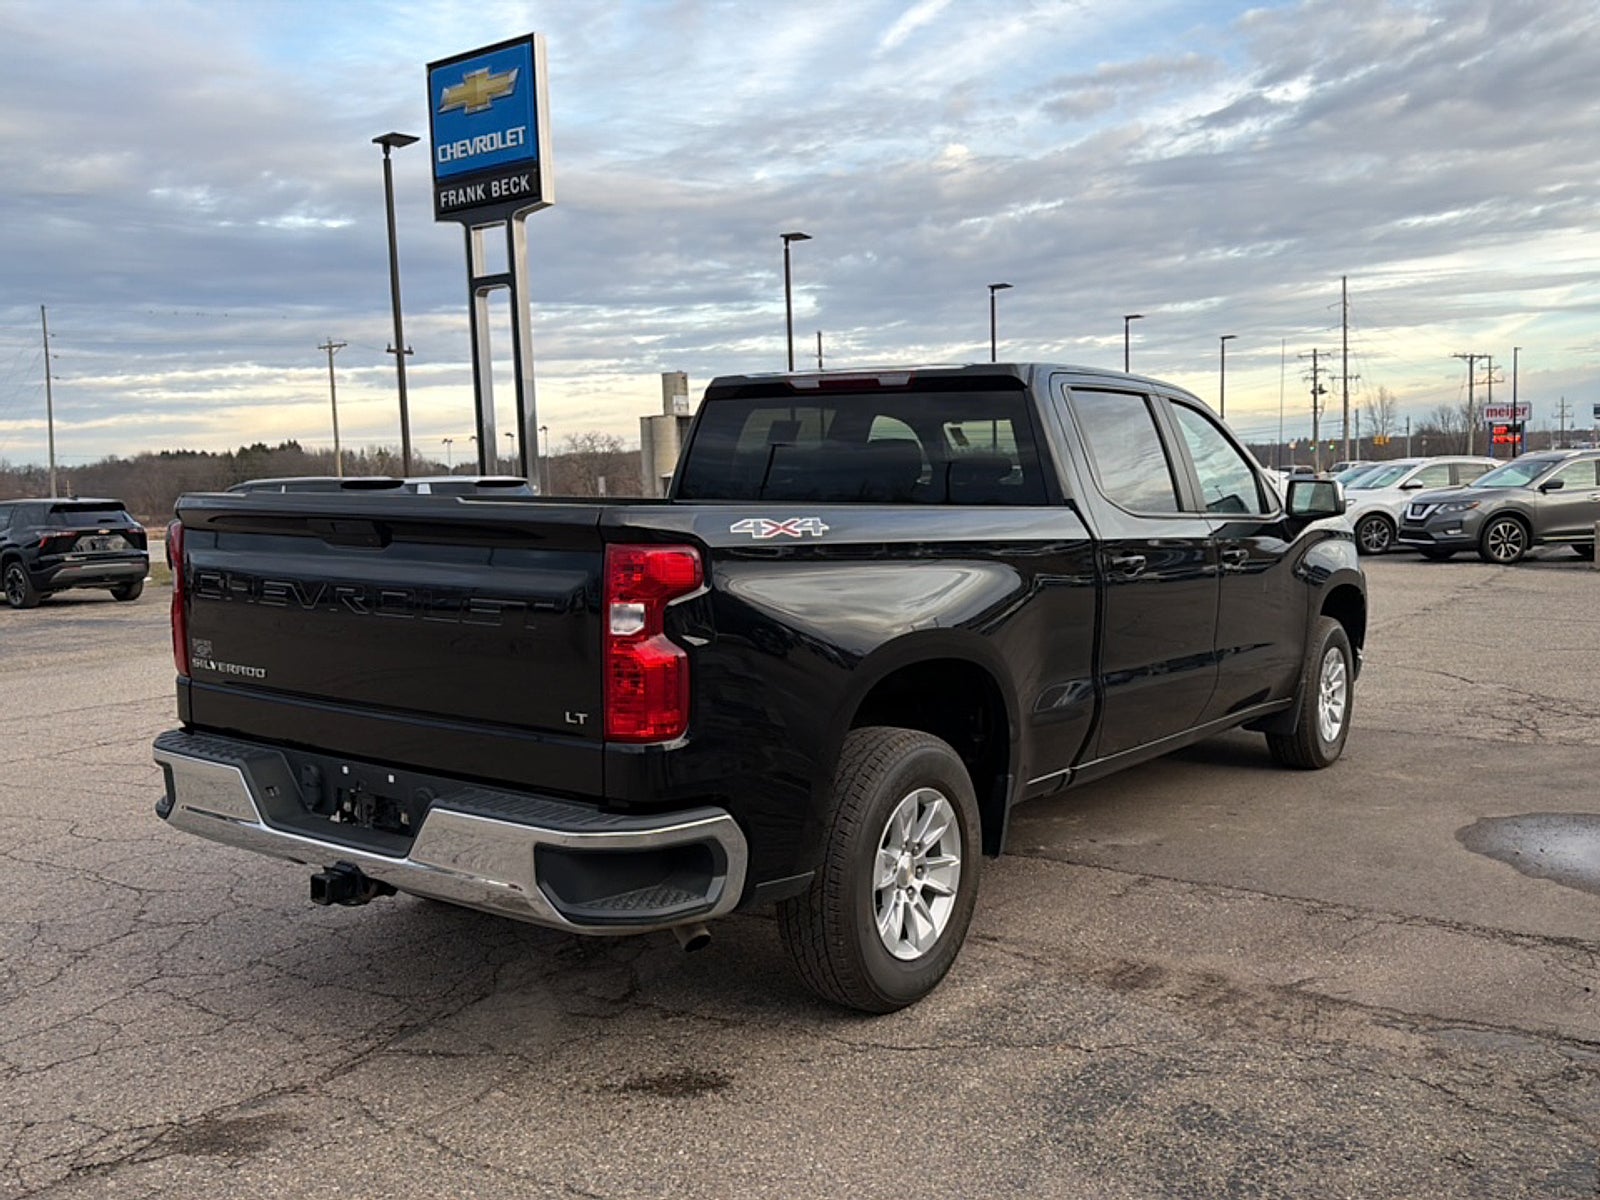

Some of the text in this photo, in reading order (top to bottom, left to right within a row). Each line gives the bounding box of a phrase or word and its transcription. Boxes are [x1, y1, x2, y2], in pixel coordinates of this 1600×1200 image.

[438, 126, 526, 162] CHEVROLET
[440, 174, 530, 208] FRANK BECK
[194, 573, 556, 629] CHEVROLET
[191, 657, 266, 678] SILVERADO
[564, 711, 589, 725] LT
